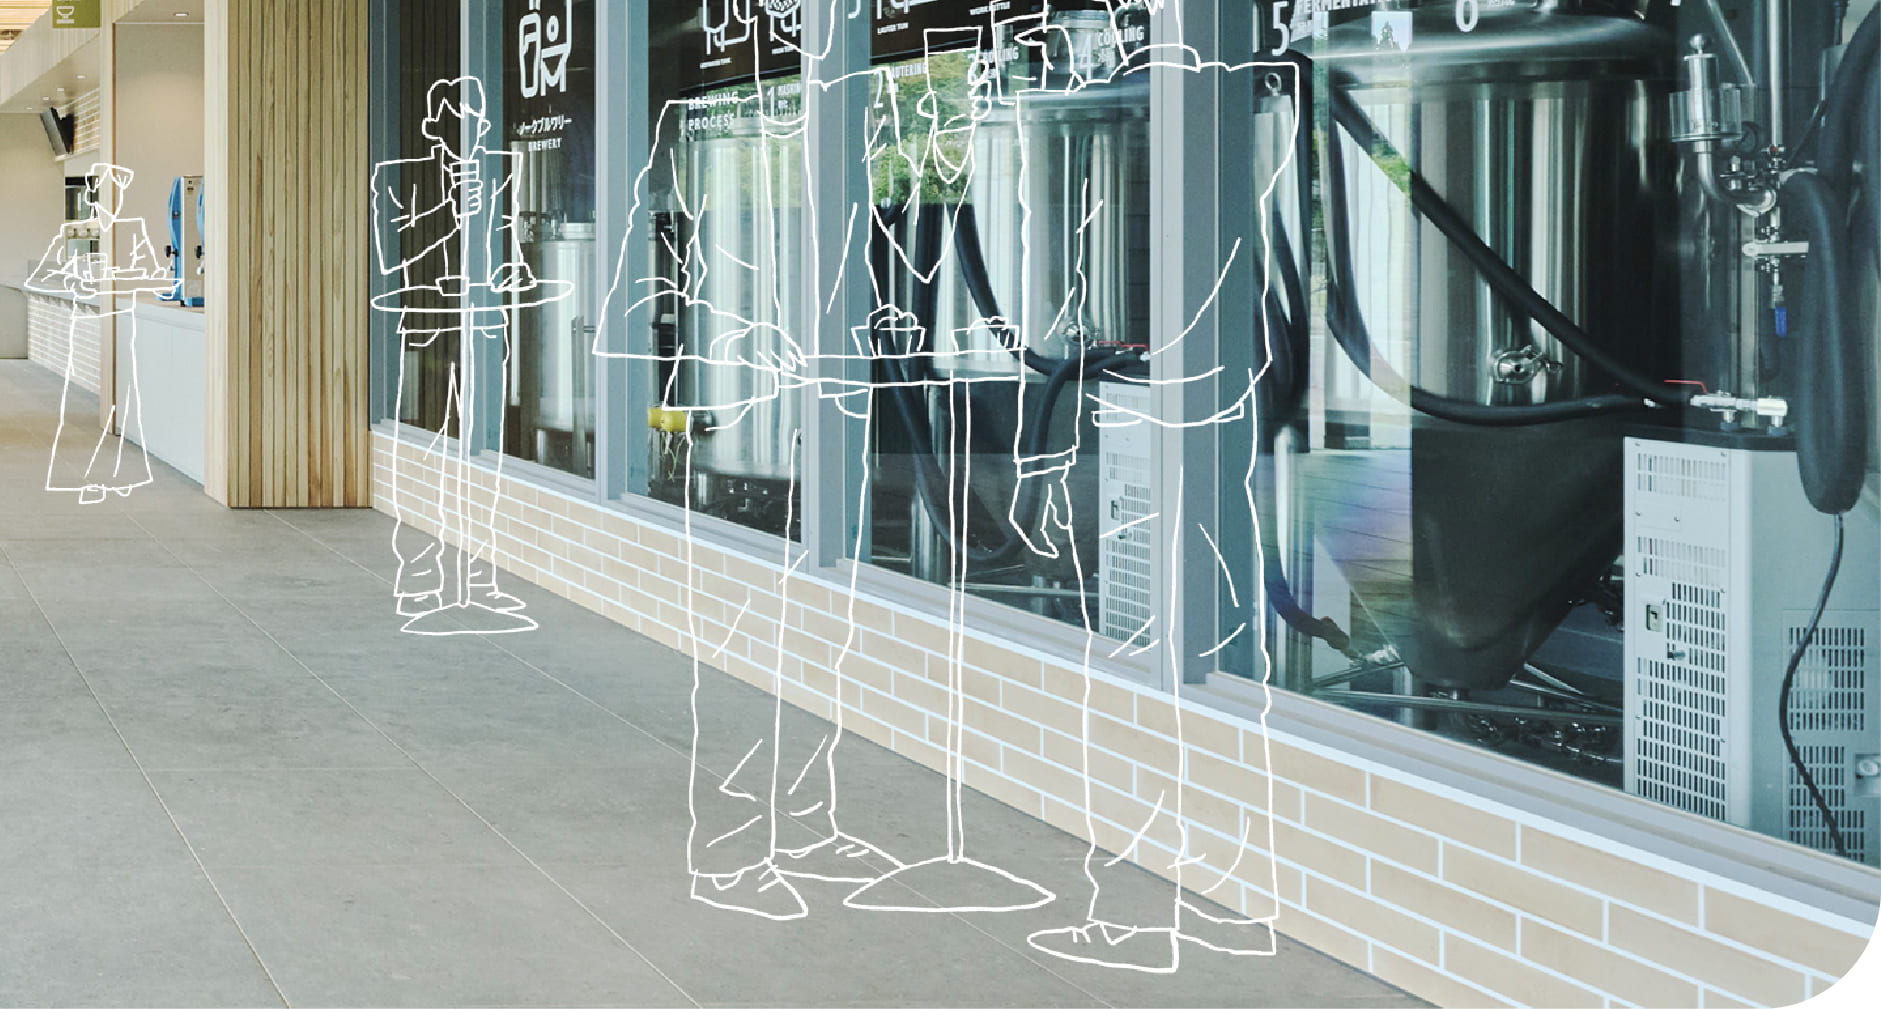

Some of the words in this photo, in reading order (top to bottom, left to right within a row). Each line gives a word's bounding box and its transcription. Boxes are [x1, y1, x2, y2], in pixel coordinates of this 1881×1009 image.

[1272, 0, 1289, 57] 5
[688, 91, 739, 111] BREWING
[688, 112, 735, 132] PROCESS
